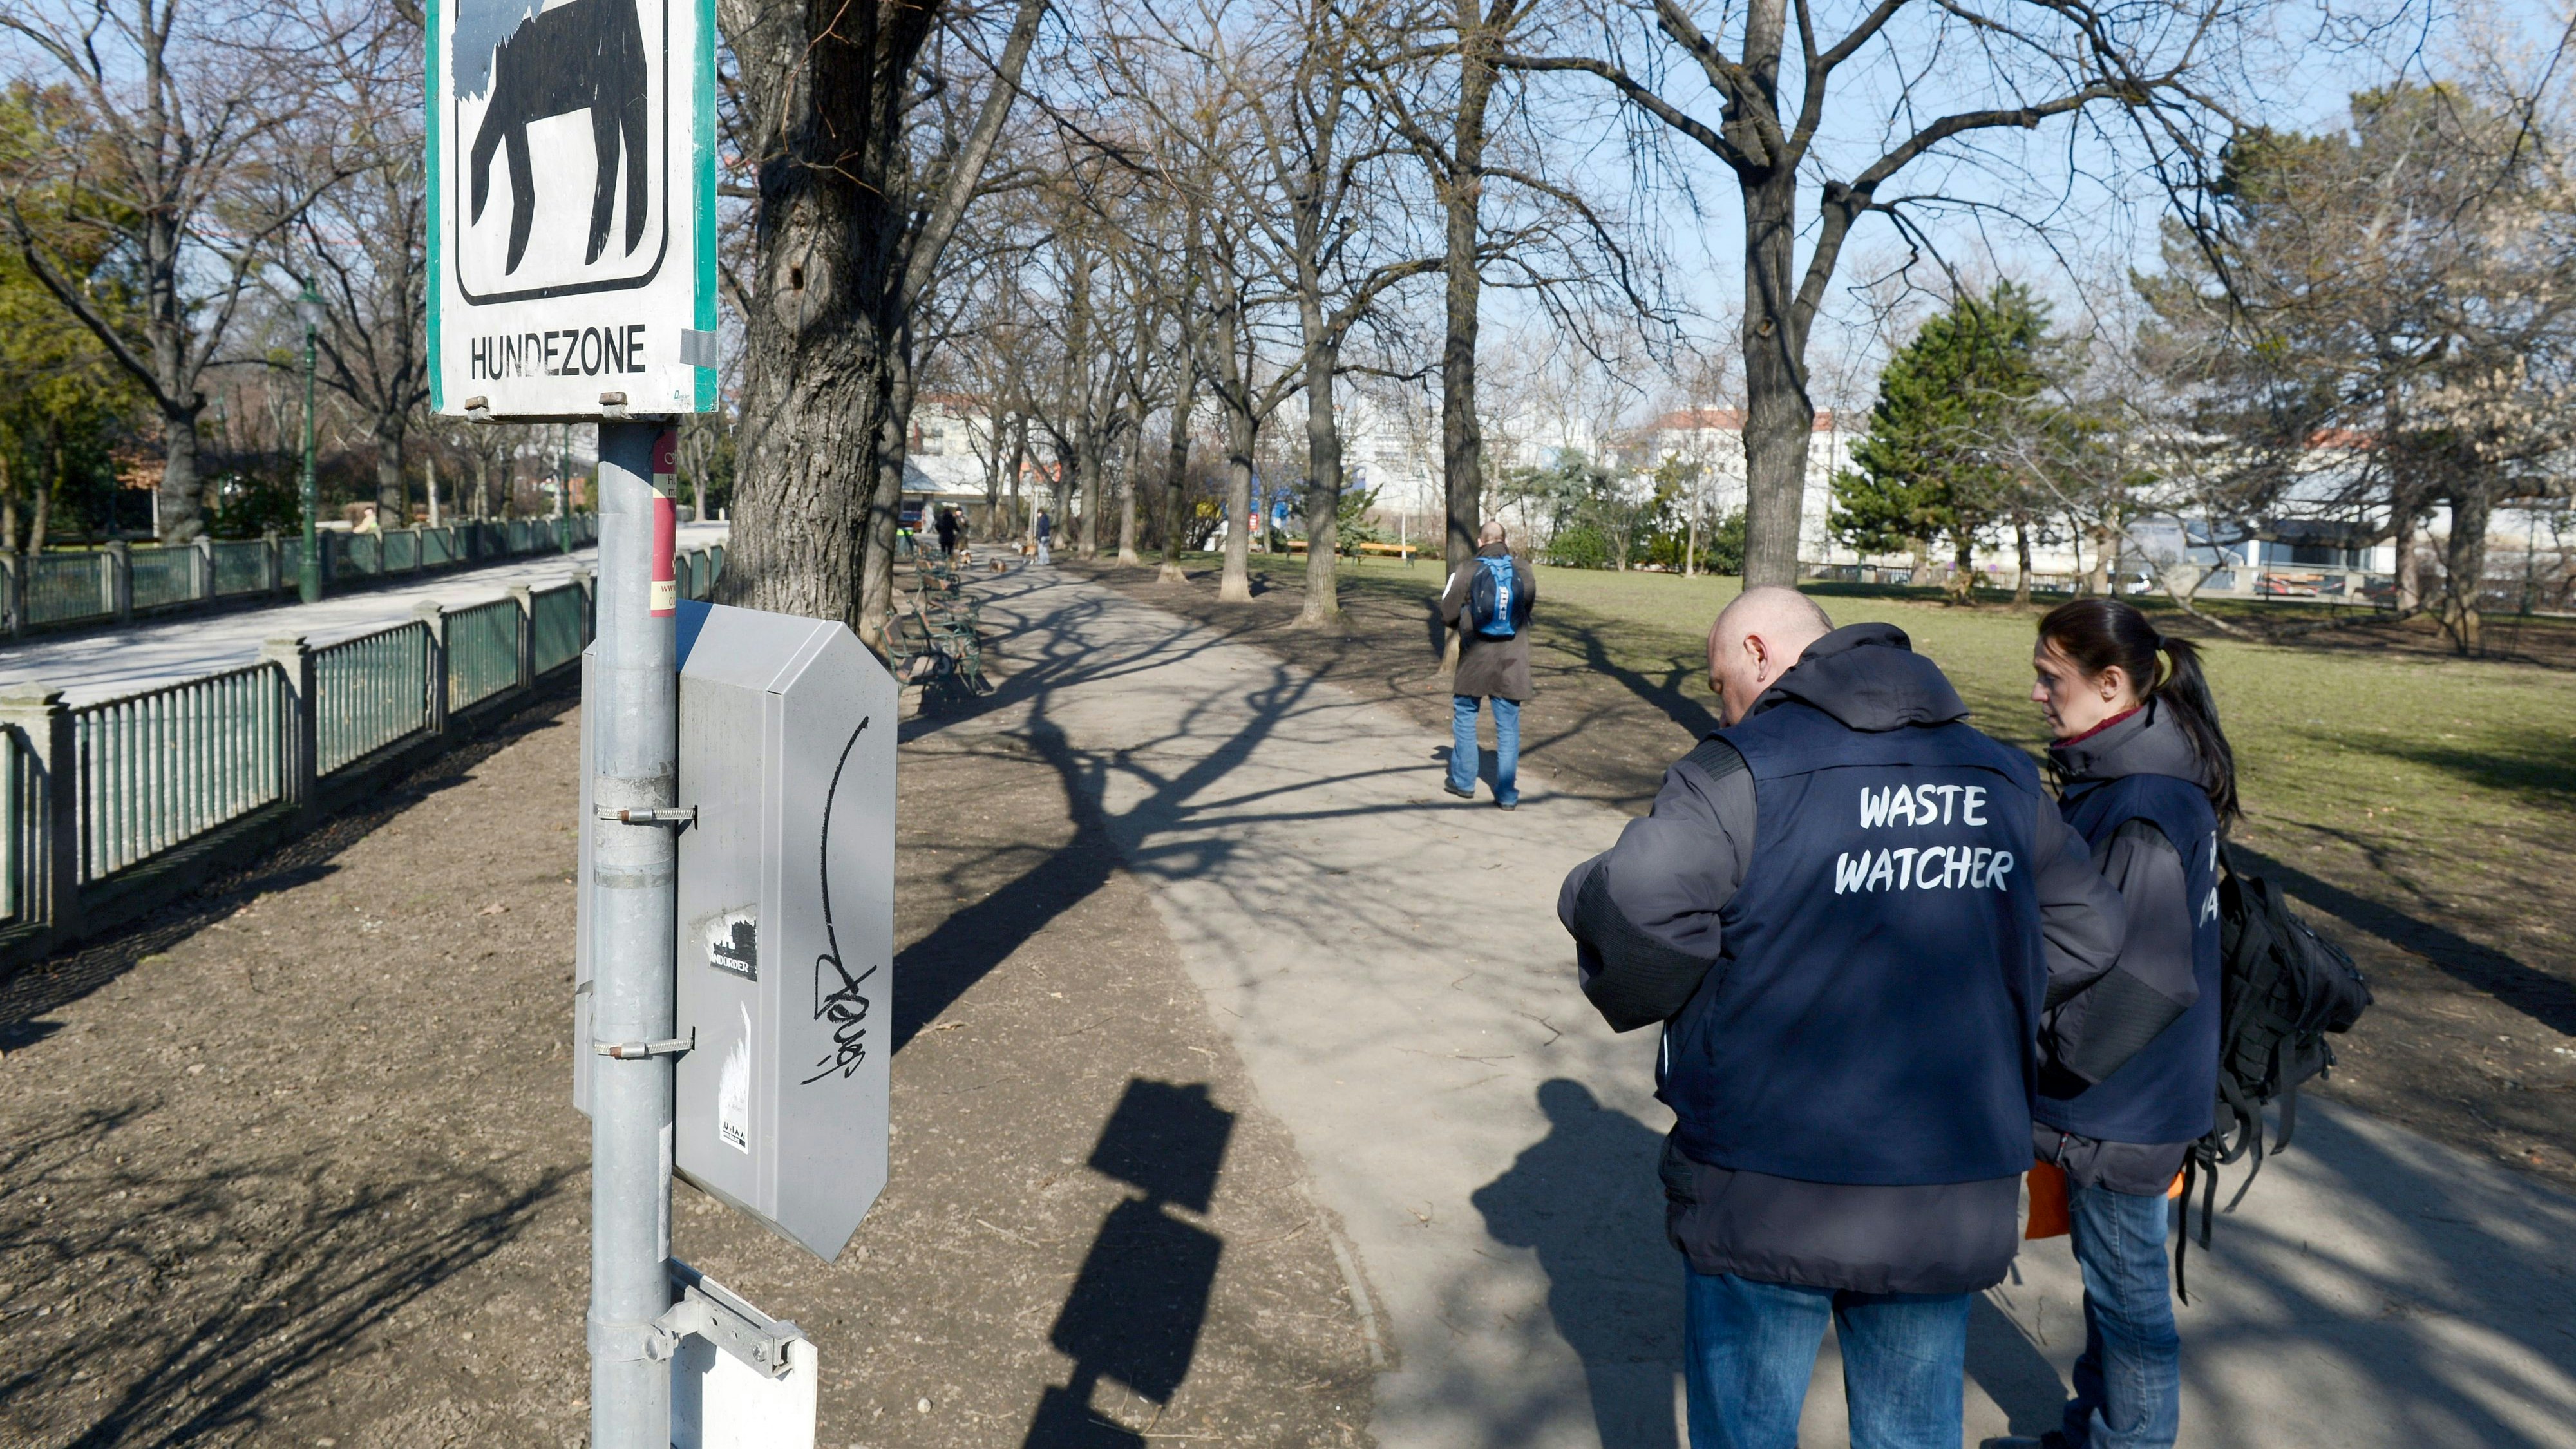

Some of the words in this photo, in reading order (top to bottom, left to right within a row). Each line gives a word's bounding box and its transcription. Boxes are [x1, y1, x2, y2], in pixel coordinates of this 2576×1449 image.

[471, 323, 645, 381] HUNDEZONE
[1860, 784, 1988, 829] WASTE
[1835, 846, 2014, 895] WATCHER
